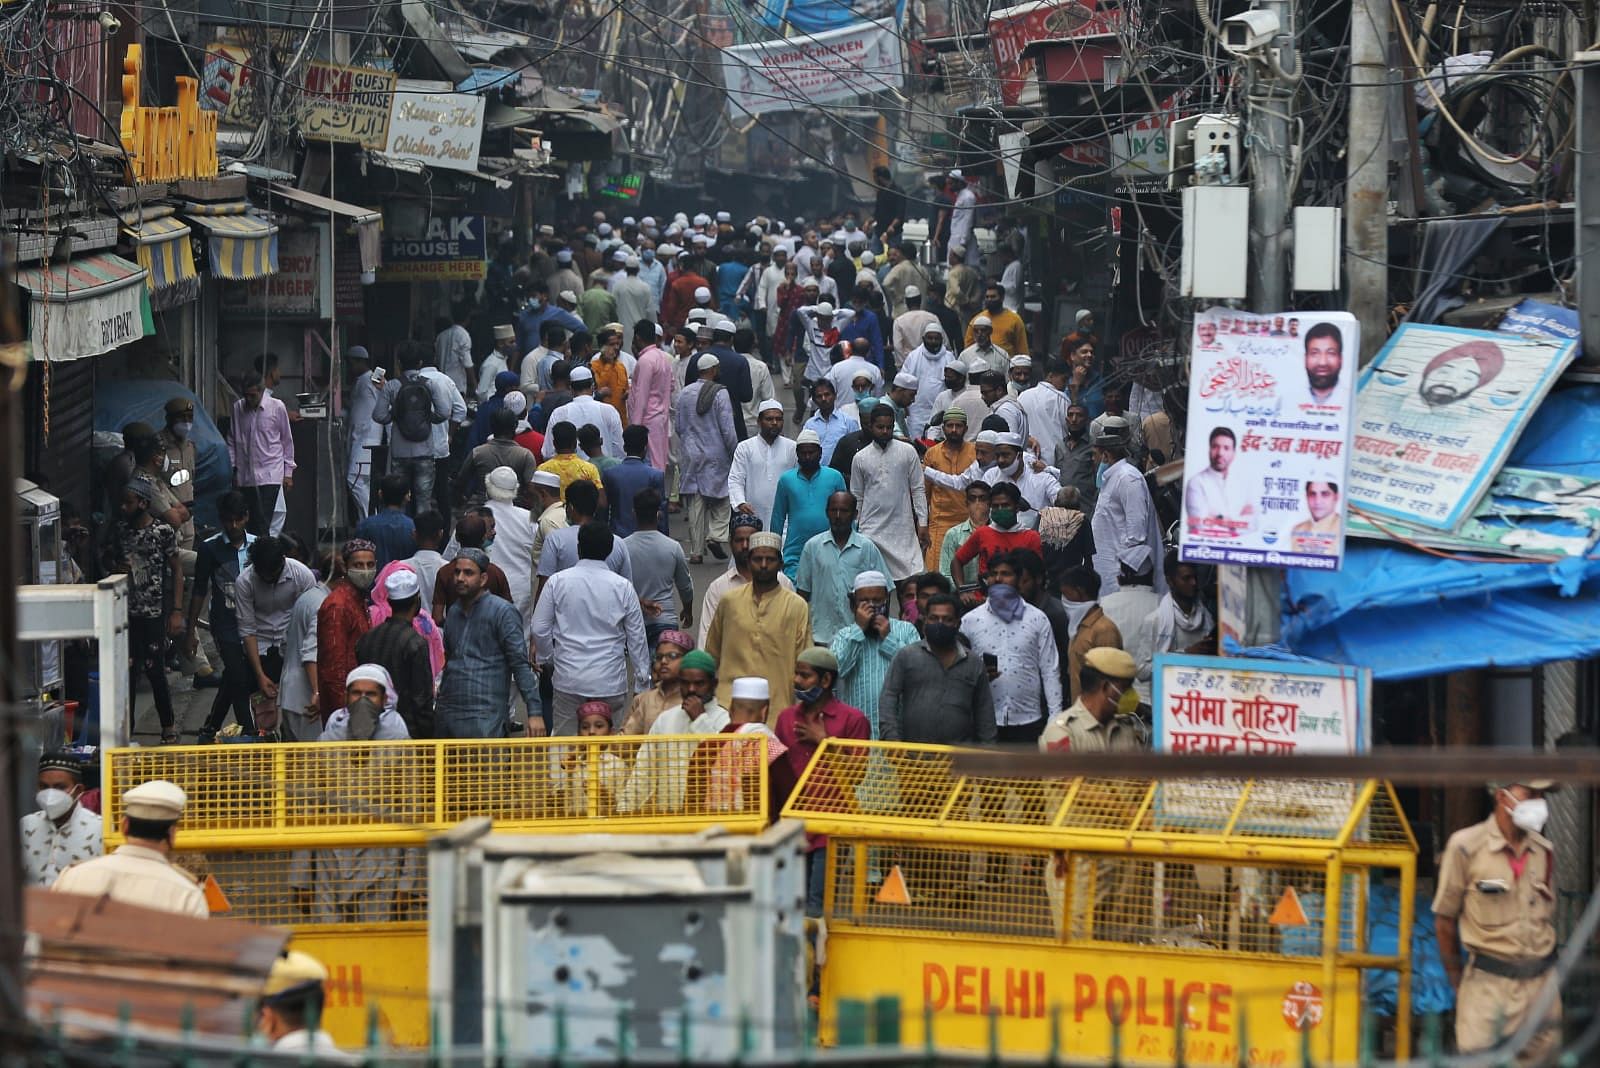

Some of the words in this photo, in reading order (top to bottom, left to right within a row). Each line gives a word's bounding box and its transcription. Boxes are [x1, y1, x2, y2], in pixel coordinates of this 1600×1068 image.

[809, 40, 863, 59] CHICKEN
[355, 73, 392, 90] GUEST
[352, 90, 390, 109] HOUSE
[429, 125, 442, 136] &
[393, 134, 437, 157] Chicken
[437, 139, 473, 159] Point
[425, 216, 476, 240] AK
[392, 242, 460, 256] HOUSE
[281, 256, 312, 273] ENCY
[449, 260, 481, 272] HERE
[250, 281, 314, 297] CHANGER
[1387, 421, 1433, 440] विकास
[1170, 689, 1228, 728] सीमा
[1231, 694, 1299, 736] ताहिरा
[922, 962, 1046, 1019] DELHI
[1074, 973, 1233, 1034] POLICE
